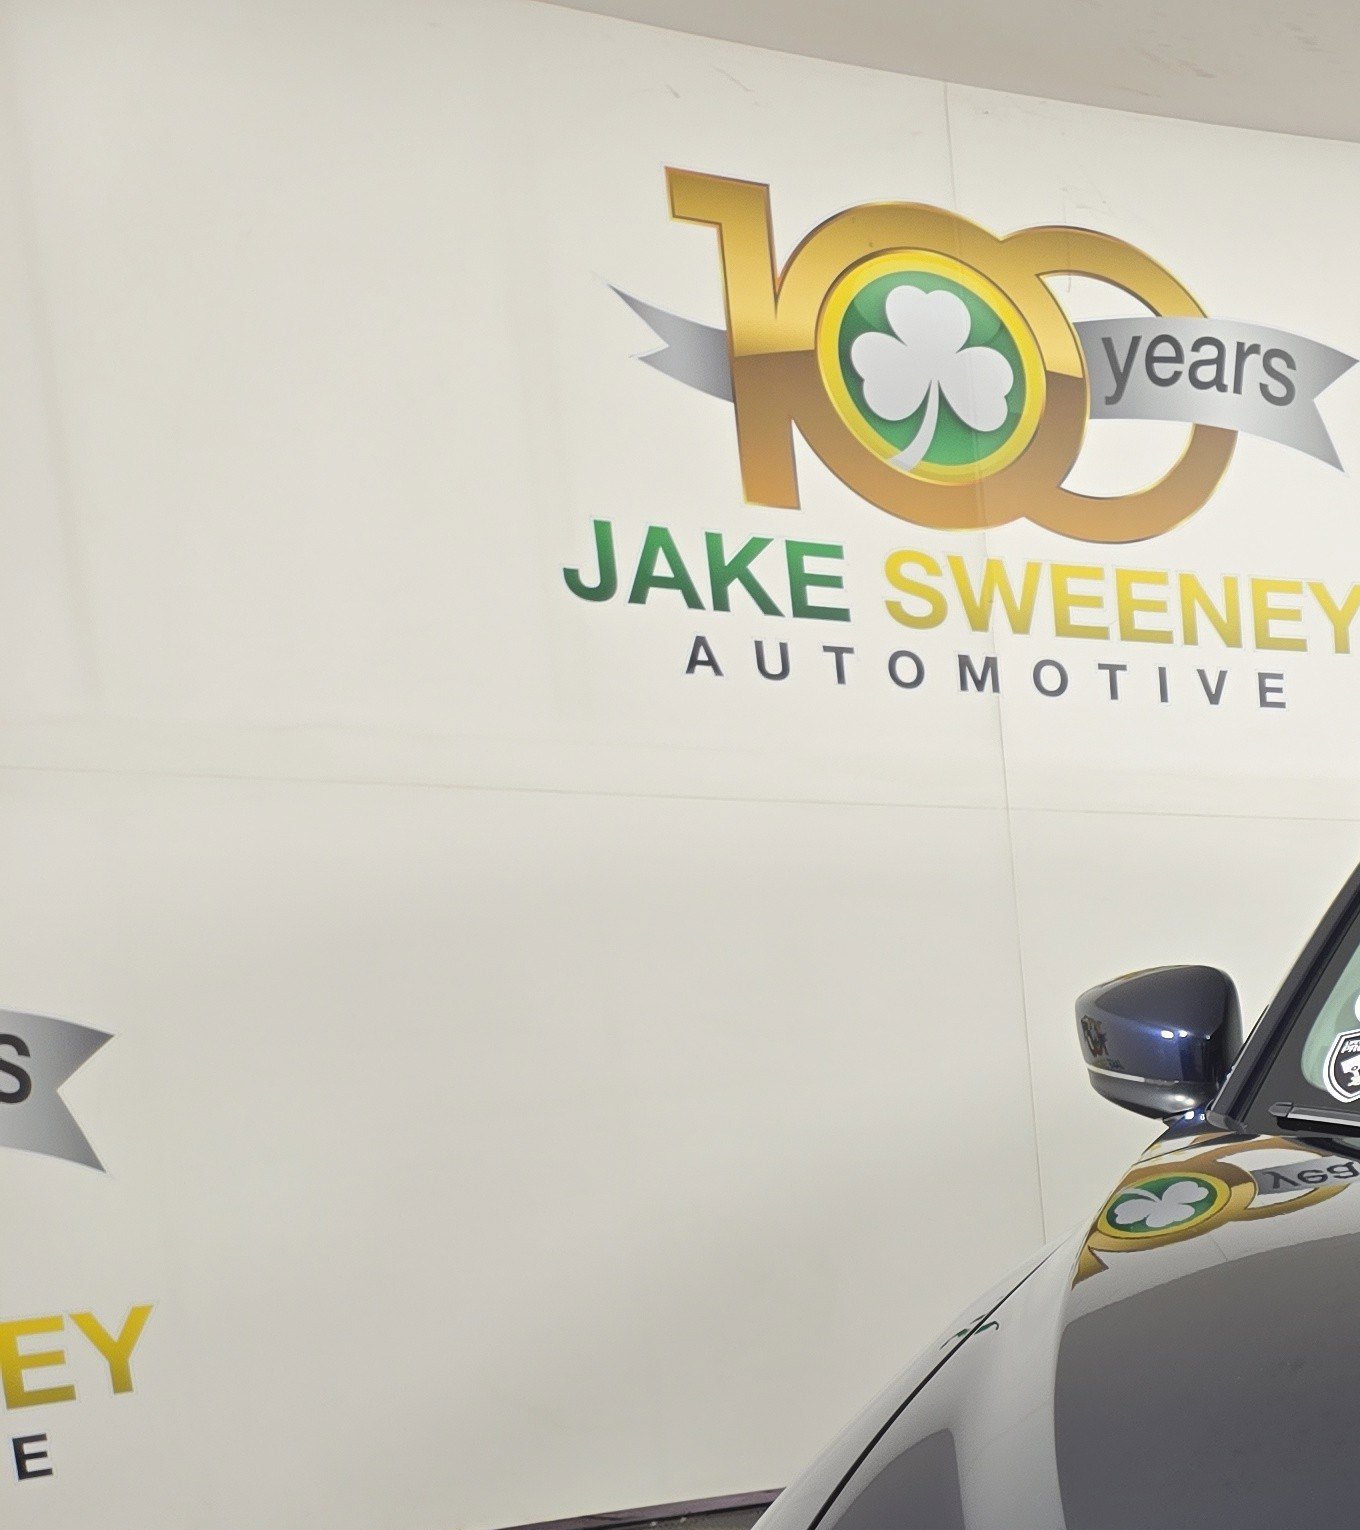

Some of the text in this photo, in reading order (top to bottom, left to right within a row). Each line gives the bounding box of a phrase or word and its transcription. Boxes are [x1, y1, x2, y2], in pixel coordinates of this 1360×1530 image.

[664, 166, 1238, 544] 100
[1101, 333, 1297, 407] years
[562, 519, 852, 623] JAKE
[685, 634, 1288, 709] AUTOMOTIVE
